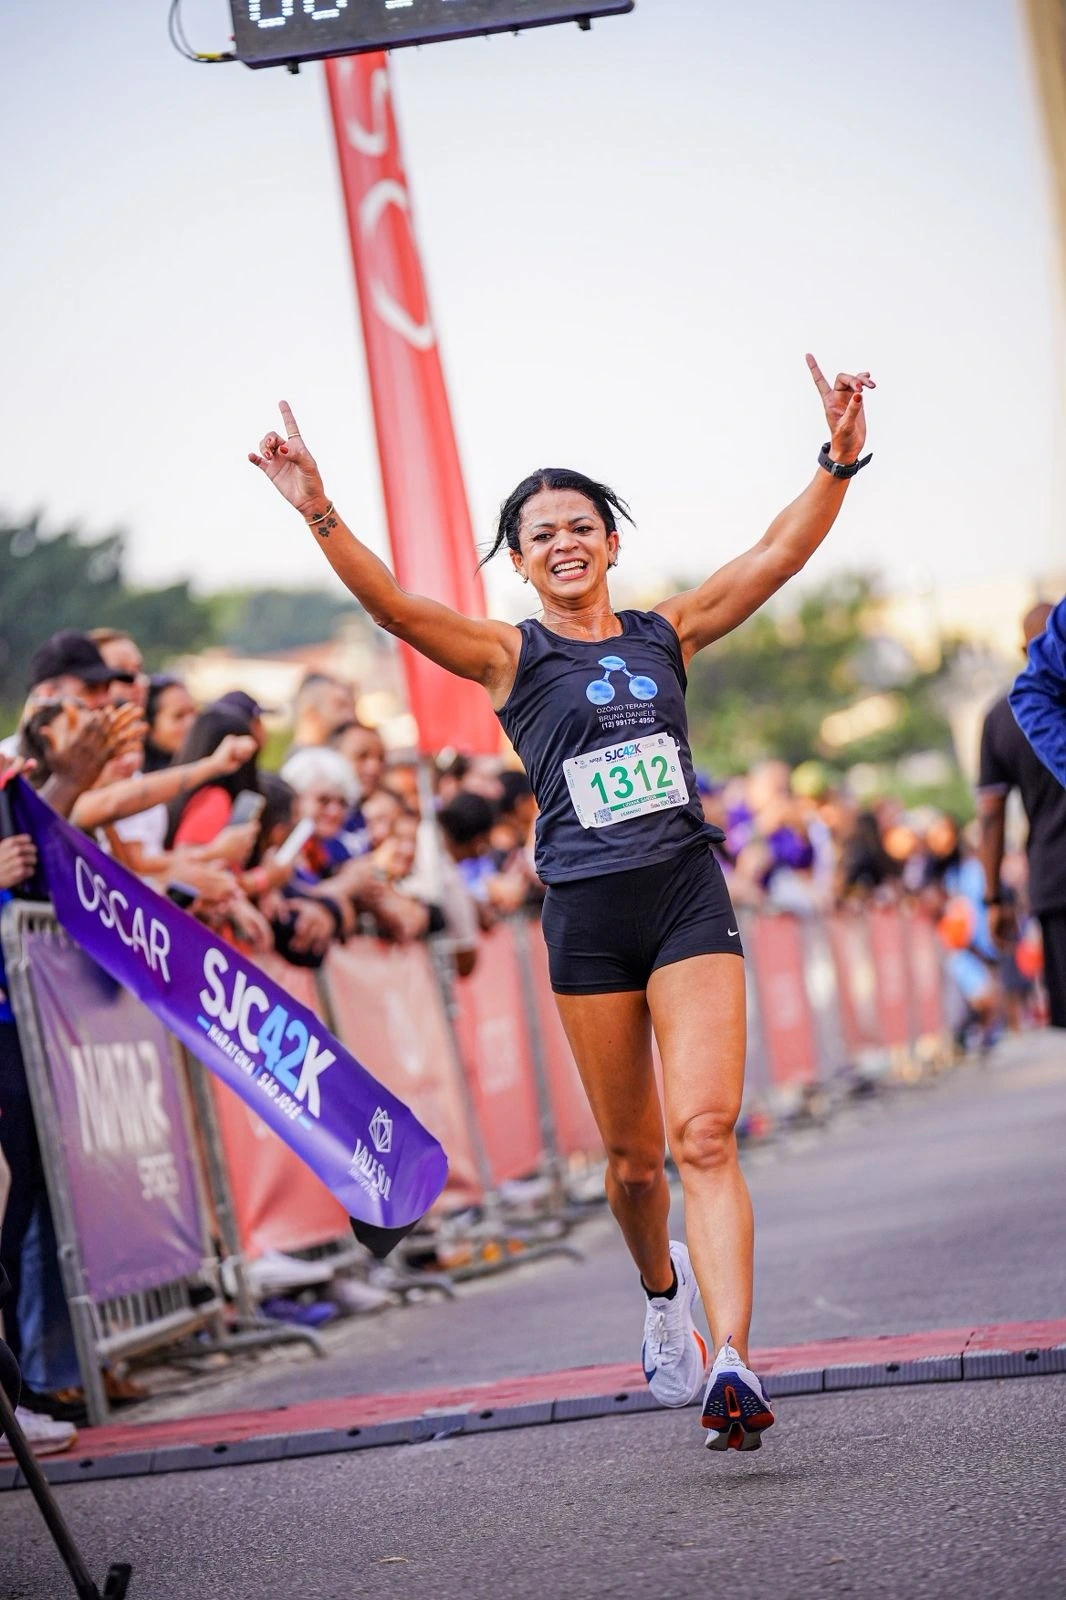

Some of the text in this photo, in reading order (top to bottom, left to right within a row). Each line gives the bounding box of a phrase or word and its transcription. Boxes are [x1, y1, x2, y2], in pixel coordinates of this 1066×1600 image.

[598, 709, 657, 723] BRUNA DANIELE
[625, 702, 655, 710] TERAPIA
[601, 721, 615, 731] (12)
[605, 743, 641, 762] SJC42K
[590, 755, 673, 804] 1312
[75, 856, 171, 983] OSCAR
[199, 947, 337, 1119] SJC42K
[207, 1023, 256, 1077] MARATONA
